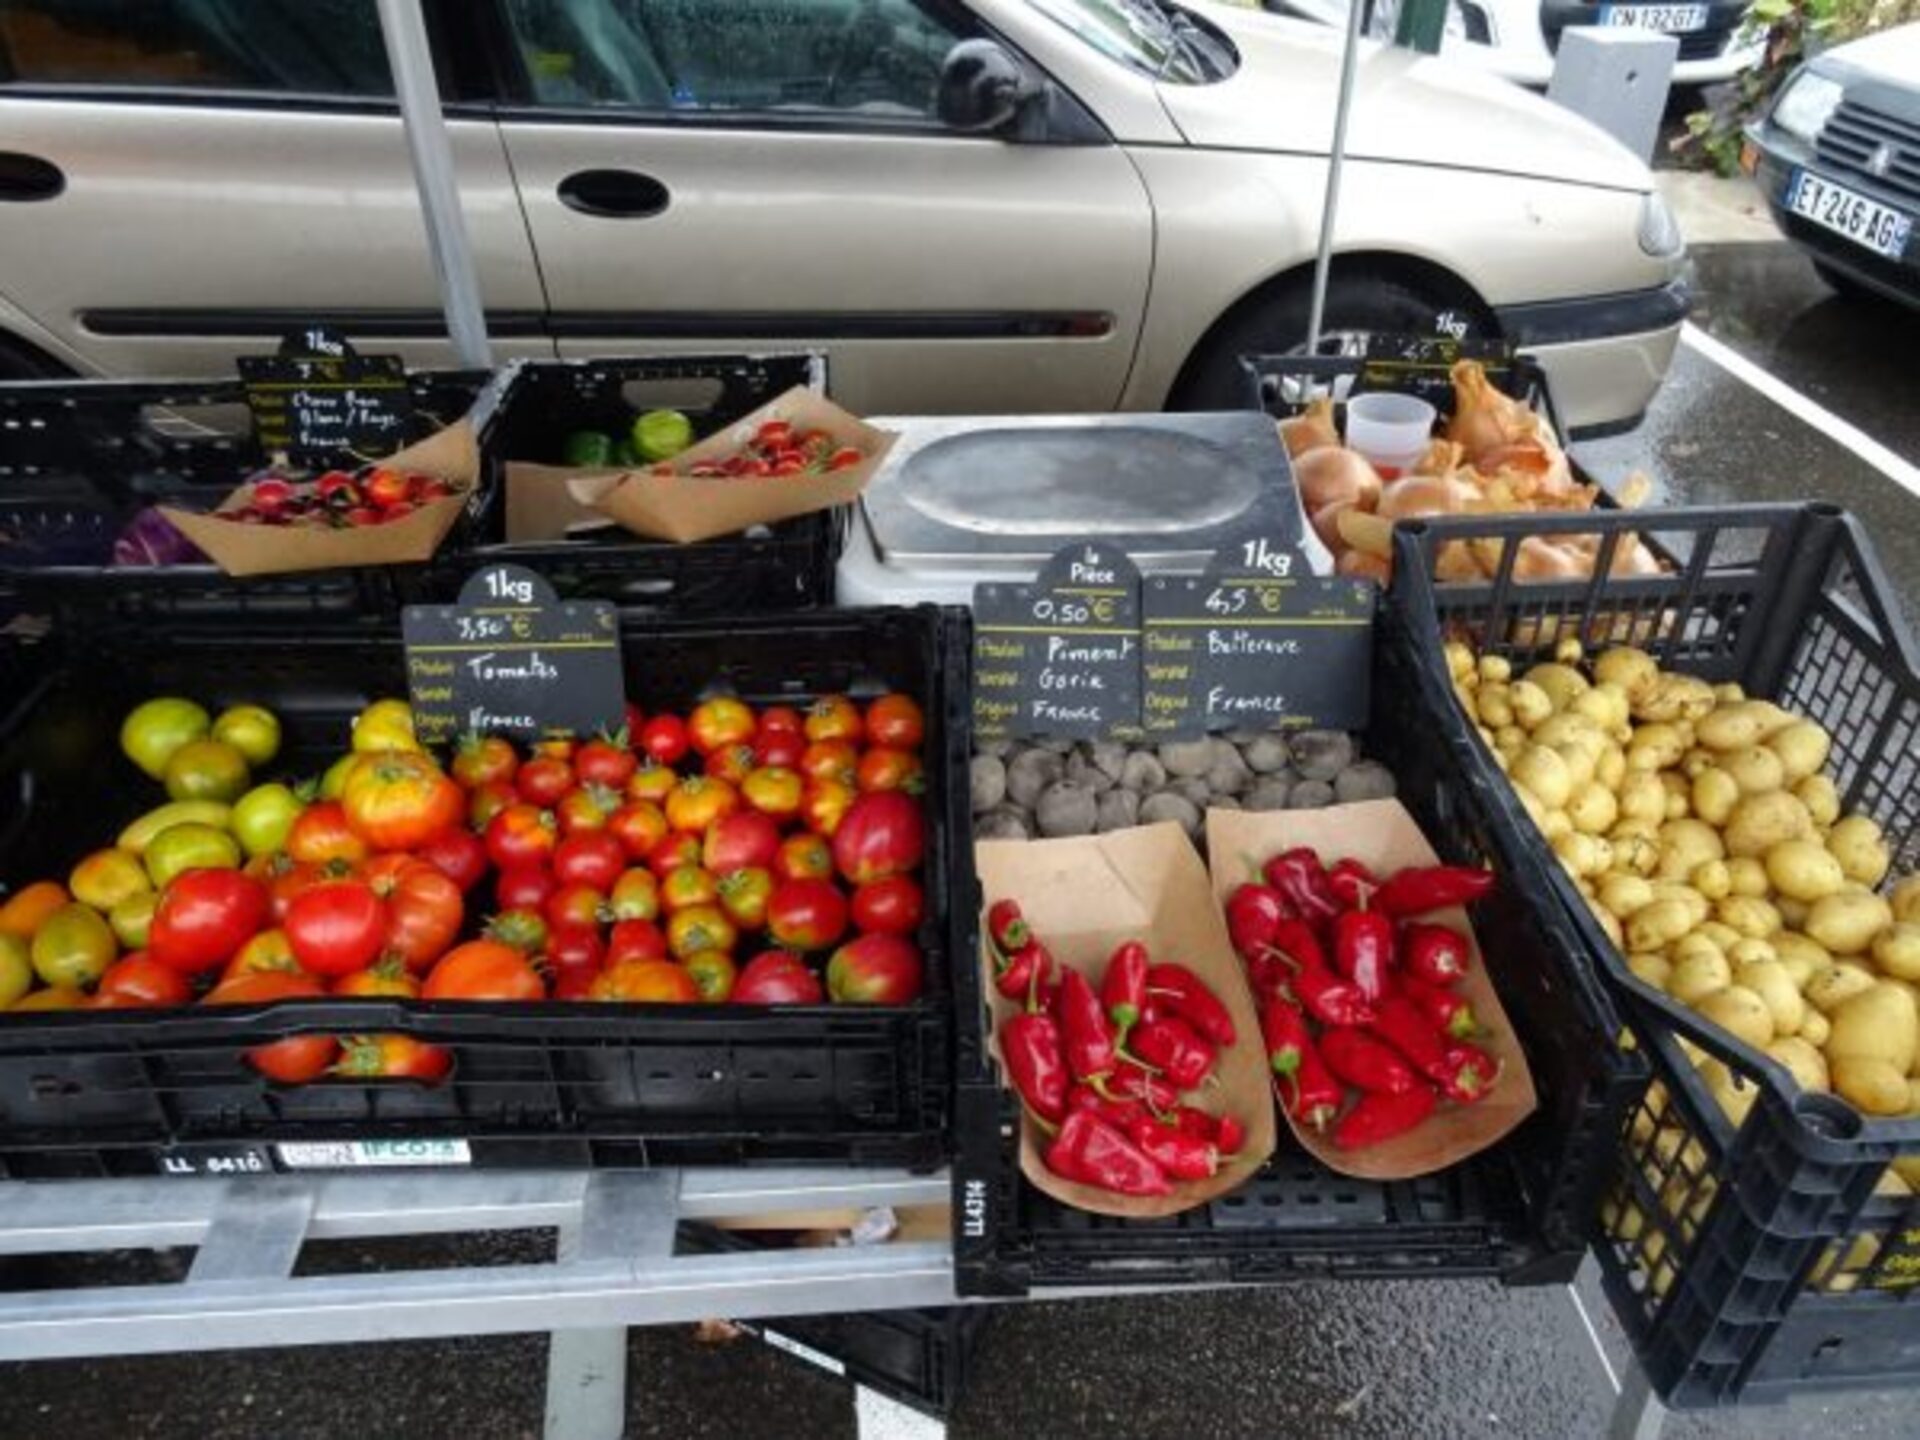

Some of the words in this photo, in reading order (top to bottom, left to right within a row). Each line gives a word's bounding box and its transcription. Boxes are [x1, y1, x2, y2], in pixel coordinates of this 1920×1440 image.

[1436, 312, 1468, 340] 1kg
[1242, 538, 1292, 577] 1kg
[485, 569, 534, 604] 1kg
